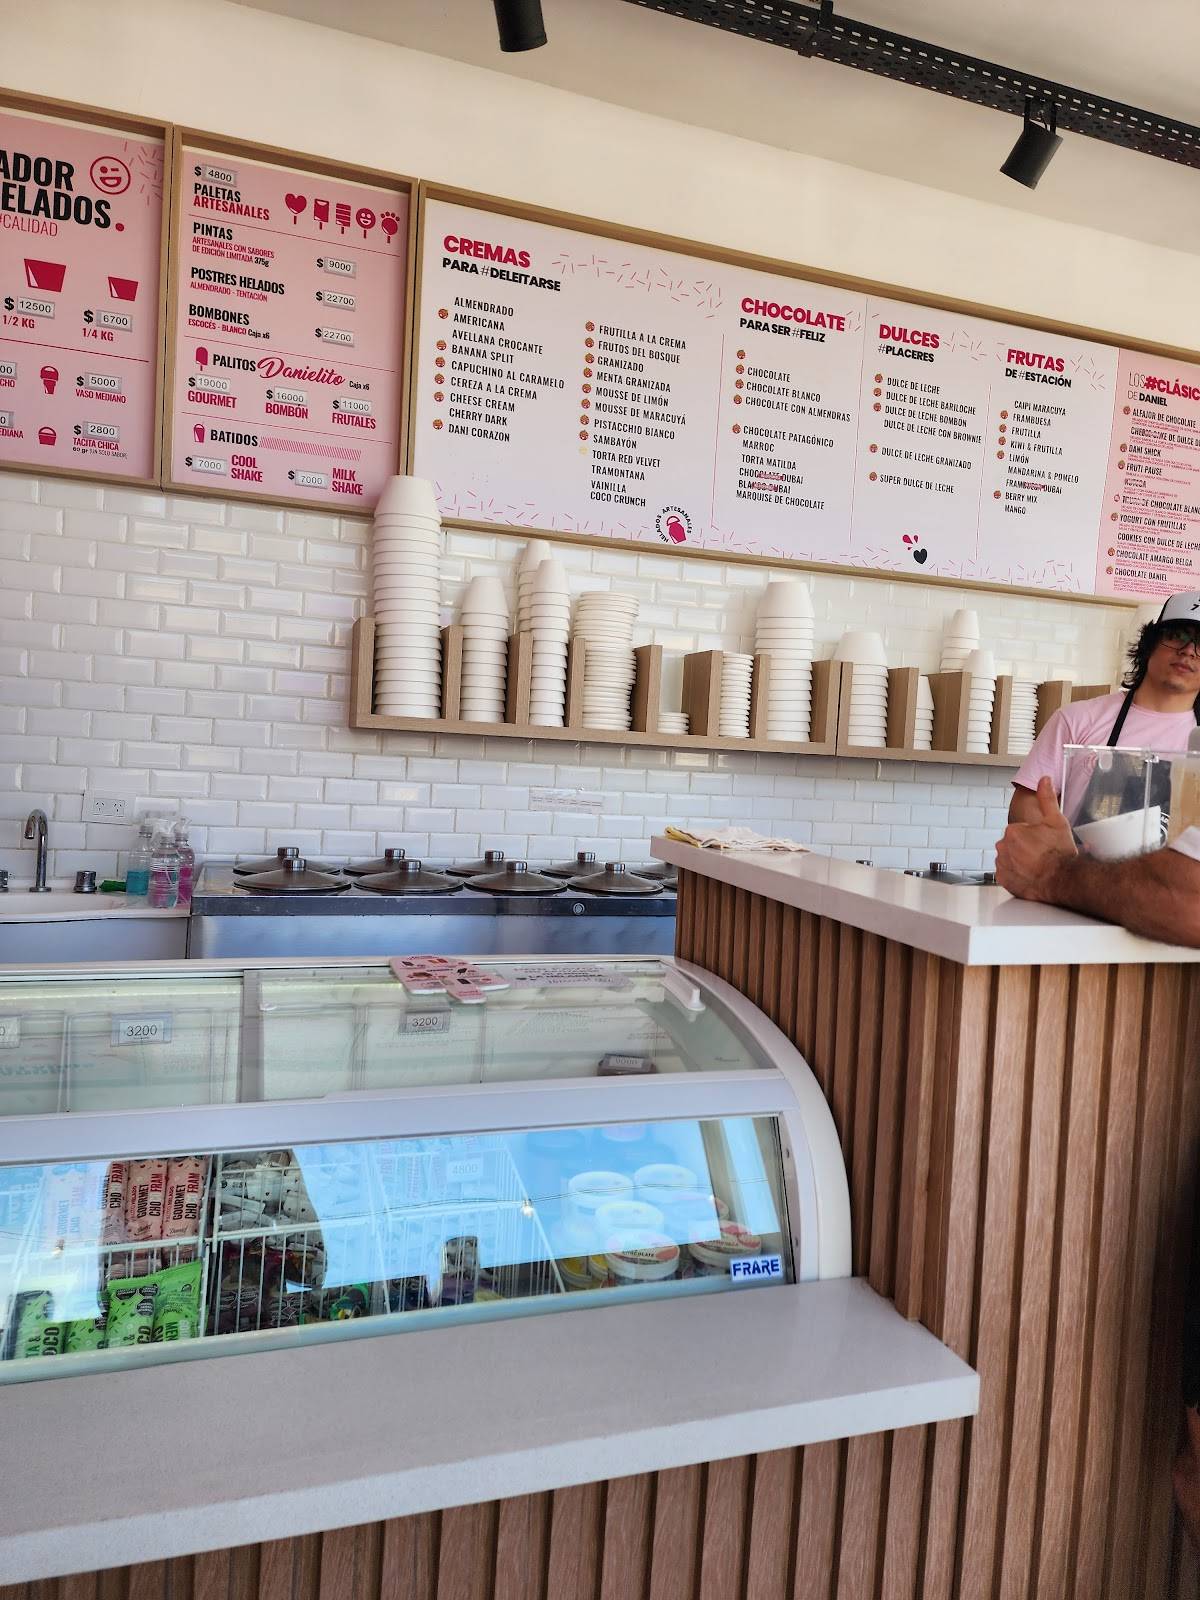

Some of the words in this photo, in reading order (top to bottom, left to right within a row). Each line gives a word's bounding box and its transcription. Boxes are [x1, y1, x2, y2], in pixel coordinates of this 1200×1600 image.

[208, 170, 232, 183] 4800
[194, 183, 241, 204] PALETAS
[194, 195, 270, 221] ARTESANALES
[194, 222, 232, 240] PINTAS
[226, 251, 253, 263] LIMITADA
[444, 236, 530, 268] CREMAS
[327, 260, 351, 272] 9000
[191, 267, 237, 286] POSTRES
[240, 276, 284, 295] HELADOS
[443, 258, 479, 275] PARA
[482, 266, 560, 292] #DELEITARSE
[190, 281, 231, 295] ALMENDRADO
[20, 301, 52, 313] 12500
[325, 294, 356, 308] 22700
[454, 297, 514, 317] ALMENDRADO
[3, 315, 19, 326] 1/2
[22, 318, 34, 329] KG
[104, 315, 127, 326] 6700
[189, 304, 249, 326] BOMBONES
[454, 313, 505, 331] AMERICANA
[742, 298, 845, 332] CHOCOLATE
[83, 328, 98, 339] 1/4
[101, 330, 113, 342] KG
[189, 318, 216, 330] ESCOCÉS
[222, 324, 246, 335] BLANCO
[740, 318, 770, 332] PARA
[772, 324, 791, 336] SER
[793, 328, 826, 343] #FELIZ
[322, 330, 352, 344] 22700
[452, 329, 495, 345] AVELLANA
[499, 338, 542, 355] CROCANTE
[600, 325, 636, 340] FRUTILLA
[660, 337, 686, 349] CREMA
[452, 344, 487, 359] BANANA
[491, 351, 514, 364] SPLIT
[599, 341, 629, 355] FRUTOS
[649, 350, 680, 364] BOSQUE
[213, 354, 258, 372] PALITOS
[257, 356, 345, 386] Danielito
[598, 356, 644, 372] GRANIZADO
[91, 377, 115, 387] 5000
[452, 361, 503, 378] CAPUCHINO
[520, 373, 564, 389] CARAMELO
[597, 371, 622, 384] MENTA
[626, 377, 670, 392] GRANIZADA
[748, 367, 790, 383] CHOCOLATE
[1018, 371, 1071, 388] #ESTACIÓN
[197, 378, 228, 391] 19000
[451, 377, 483, 391] CEREZA
[508, 387, 537, 400] CREMA
[747, 382, 789, 397] CHOCOLATE
[792, 390, 820, 402] BLANCO
[76, 389, 94, 399] VASO
[188, 390, 237, 408] GOURMET
[275, 392, 304, 404] 16000
[450, 393, 482, 407] CHEESE
[486, 399, 515, 412] CREAM
[596, 387, 628, 401] MOUSSE
[340, 399, 372, 414] 11000
[596, 402, 627, 416] MOUSSE
[643, 410, 686, 425] MARACUYÁ
[746, 396, 788, 412] CHOCOLATE
[808, 407, 850, 422] ALMENDRAS
[332, 413, 376, 430] FRUTALES
[449, 408, 482, 422] CHERRY
[485, 414, 507, 426] DARK
[90, 425, 115, 435] 2800
[449, 424, 468, 436] DANI
[472, 428, 510, 442] CORAZON
[594, 419, 642, 435] PISTACCHIO
[645, 427, 675, 440] BIANCO
[744, 426, 786, 440] CHOCOLATE
[789, 433, 834, 448] PATAGÓNICO
[73, 438, 96, 448] TACITA
[98, 442, 118, 451] CHICA
[211, 430, 260, 447] BATIDOS
[594, 434, 636, 449] SAMBAYÓN
[743, 440, 774, 452] MARROC
[199, 459, 222, 470] 7000
[232, 455, 257, 469] COOL
[593, 450, 616, 462] TORTA
[619, 454, 633, 464] RED
[636, 456, 660, 468] VELVET
[742, 454, 764, 465] TORTA
[767, 458, 796, 470] MATILDA
[231, 468, 263, 482] SHAKE
[301, 476, 323, 487] 7000
[333, 468, 356, 482] MILK
[592, 465, 645, 481] TRAMONTANA
[332, 481, 363, 496] SHAKE
[591, 480, 626, 493] VAINILLA
[591, 491, 611, 502] COCO
[614, 495, 646, 507] CRUNCH
[737, 490, 772, 503] MARQUISE
[786, 497, 824, 510] CHOCOLATE
[412, 1016, 438, 1027] 3200
[126, 1025, 158, 1036] 3200
[150, 1173, 163, 1192] FRAM
[187, 1173, 200, 1193] FRAM
[137, 1184, 148, 1218] GOURMET
[173, 1185, 185, 1220] GOURMET
[733, 1260, 780, 1276] FRARE
